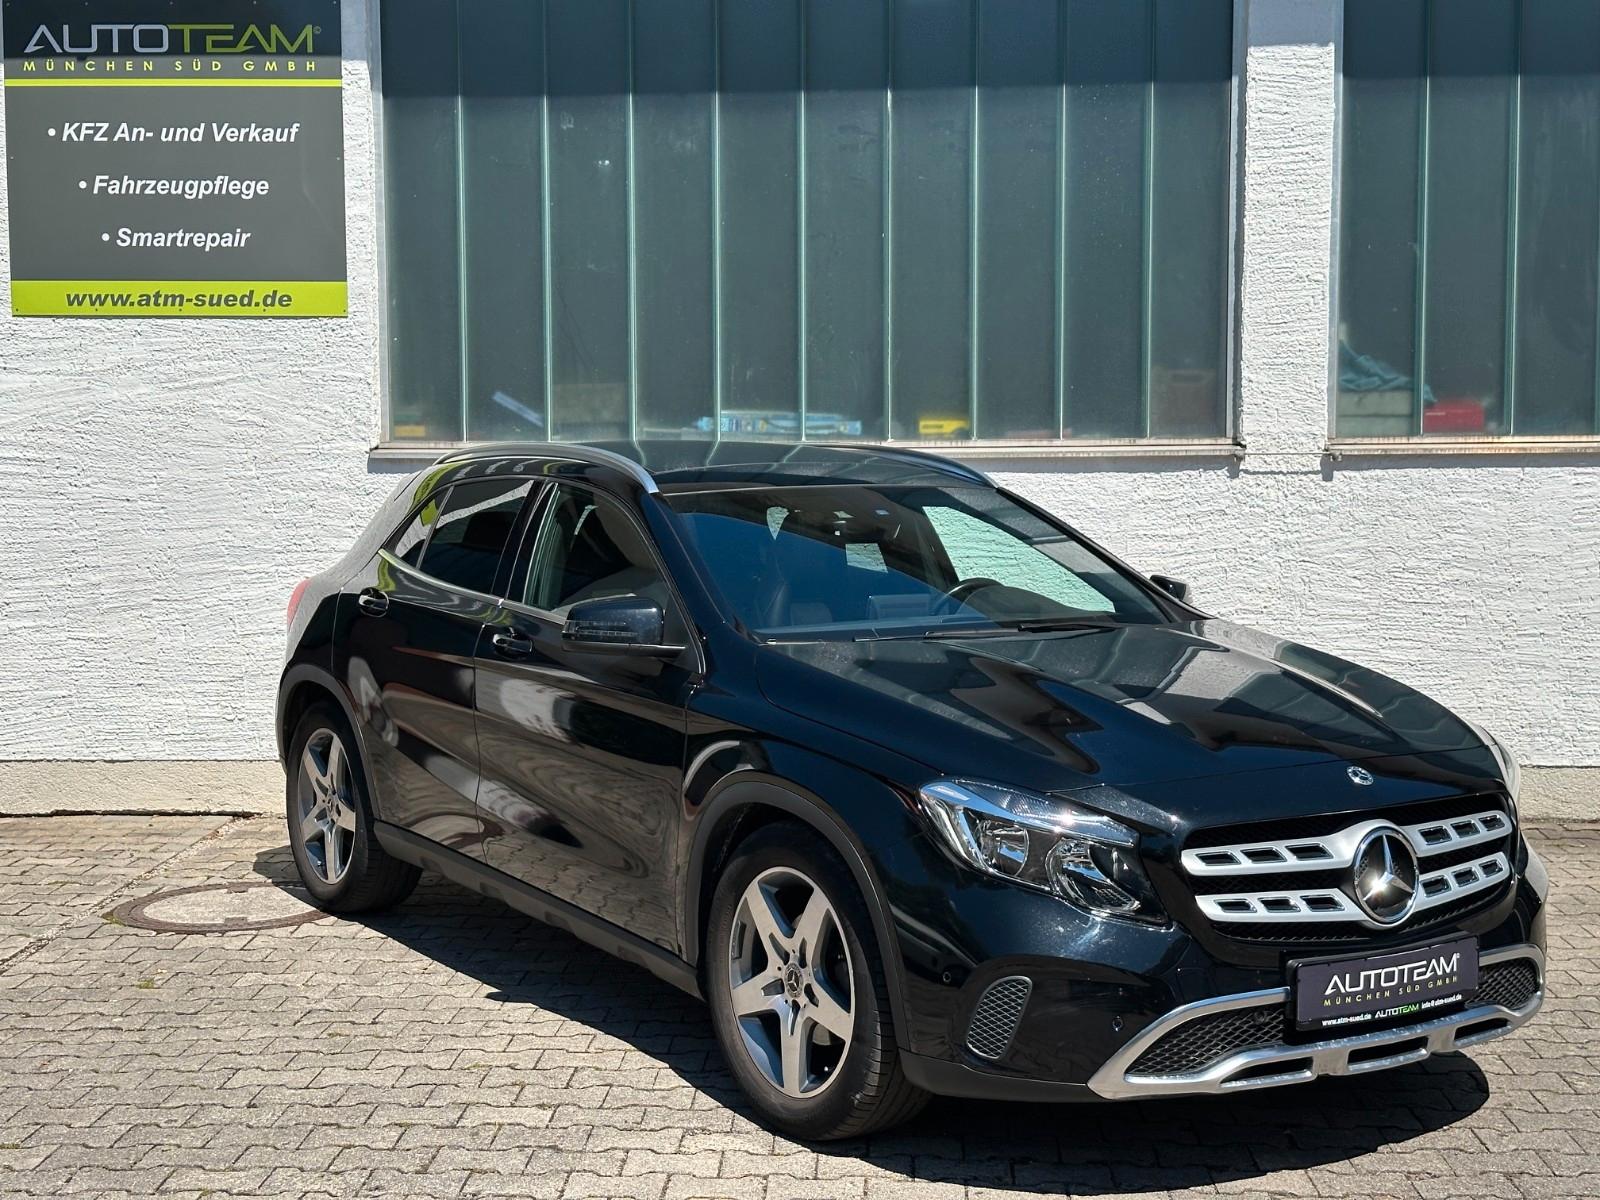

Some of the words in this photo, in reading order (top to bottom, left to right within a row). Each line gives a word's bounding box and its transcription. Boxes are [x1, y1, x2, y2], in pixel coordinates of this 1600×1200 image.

[23, 59, 154, 72] MÜNCHEN
[174, 58, 222, 72] SÜD
[243, 60, 316, 72] GMBH
[61, 122, 109, 142] KFZ
[113, 123, 154, 142] An-
[160, 122, 205, 142] und
[211, 122, 300, 142] Verkauf
[92, 175, 270, 200] Fahrzeugpflege
[115, 227, 251, 251] Smartrepair
[65, 290, 293, 308] www.atm-sued.de
[1323, 989, 1390, 1006] MÜNCHEN
[1398, 984, 1420, 996] SÜD
[1427, 975, 1458, 989] GMBH
[1321, 1013, 1372, 1026] www.atm-sued.de
[1374, 1002, 1420, 1019] AUTOTEAM
